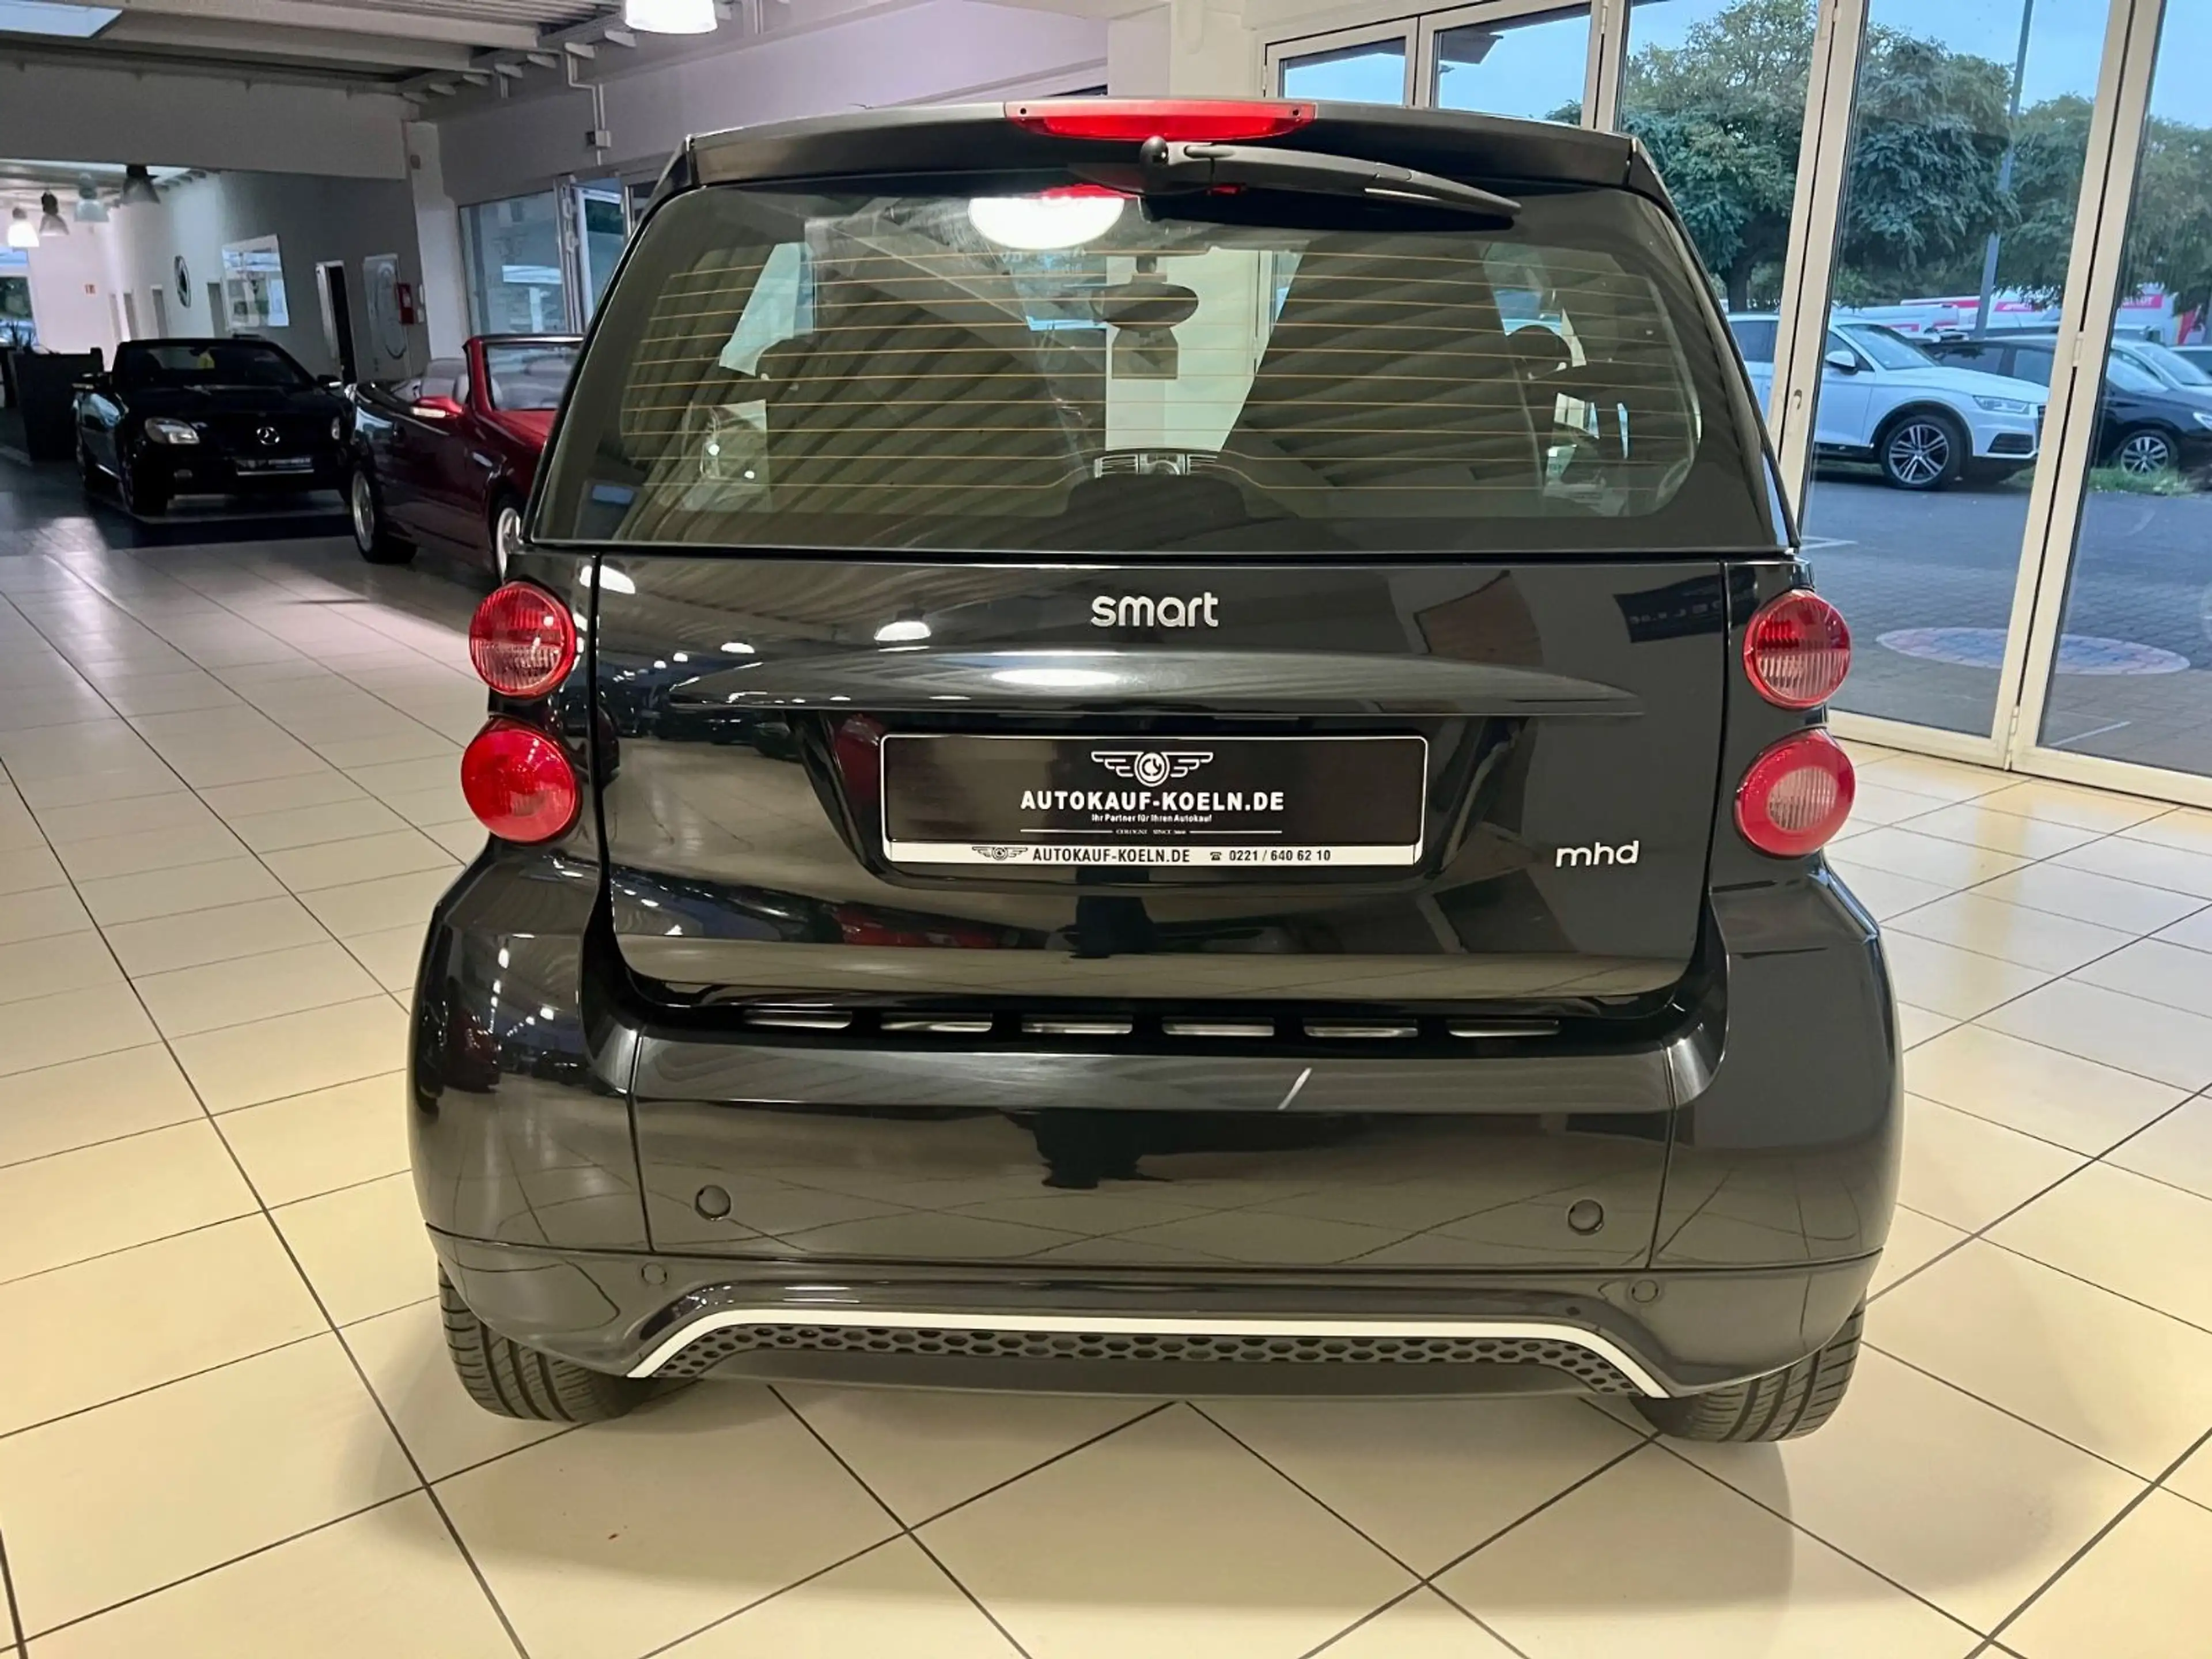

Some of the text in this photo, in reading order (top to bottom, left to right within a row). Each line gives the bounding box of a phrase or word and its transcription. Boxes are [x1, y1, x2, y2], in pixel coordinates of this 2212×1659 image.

[1090, 592, 1219, 627] smart
[1020, 790, 1285, 811] AUTOKAUF-KOELN.DE
[1092, 813, 1213, 823] Ihr Partner für Ihren Autokauf
[1032, 847, 1331, 863] AUTOKAUF-KOELN.DE 0221 / 640 62 10
[1556, 840, 1639, 868] mhd
